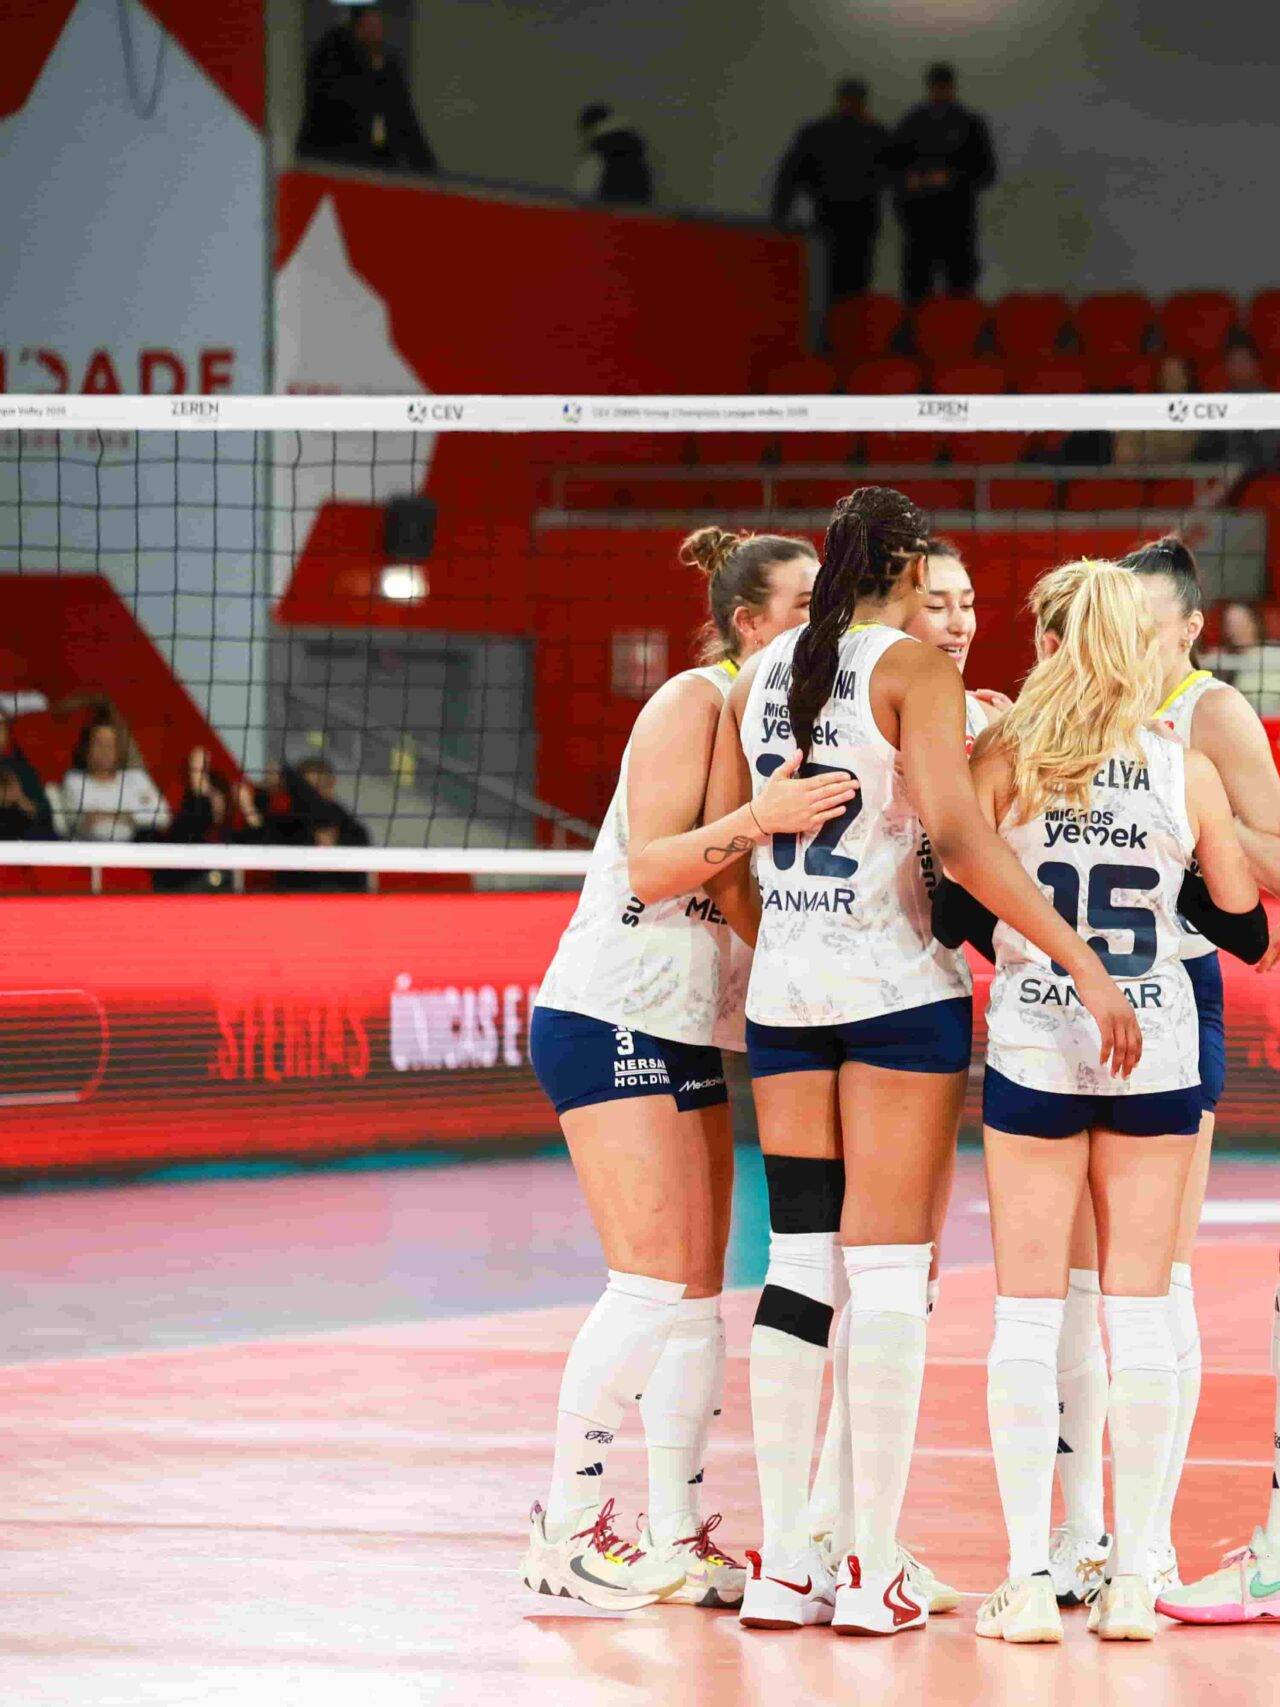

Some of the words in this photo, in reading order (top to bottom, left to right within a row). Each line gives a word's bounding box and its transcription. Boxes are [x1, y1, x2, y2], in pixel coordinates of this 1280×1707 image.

[171, 401, 219, 415] ZEREN
[431, 404, 464, 420] CEV
[918, 401, 968, 416] ZEREN
[1194, 403, 1228, 419] CEV
[761, 717, 839, 748] yeek
[1093, 758, 1150, 791] ELYA
[759, 884, 853, 915] ANMAR
[1037, 861, 1160, 977] 15
[1020, 978, 1162, 1009] SANAR
[616, 1031, 634, 1055] 3
